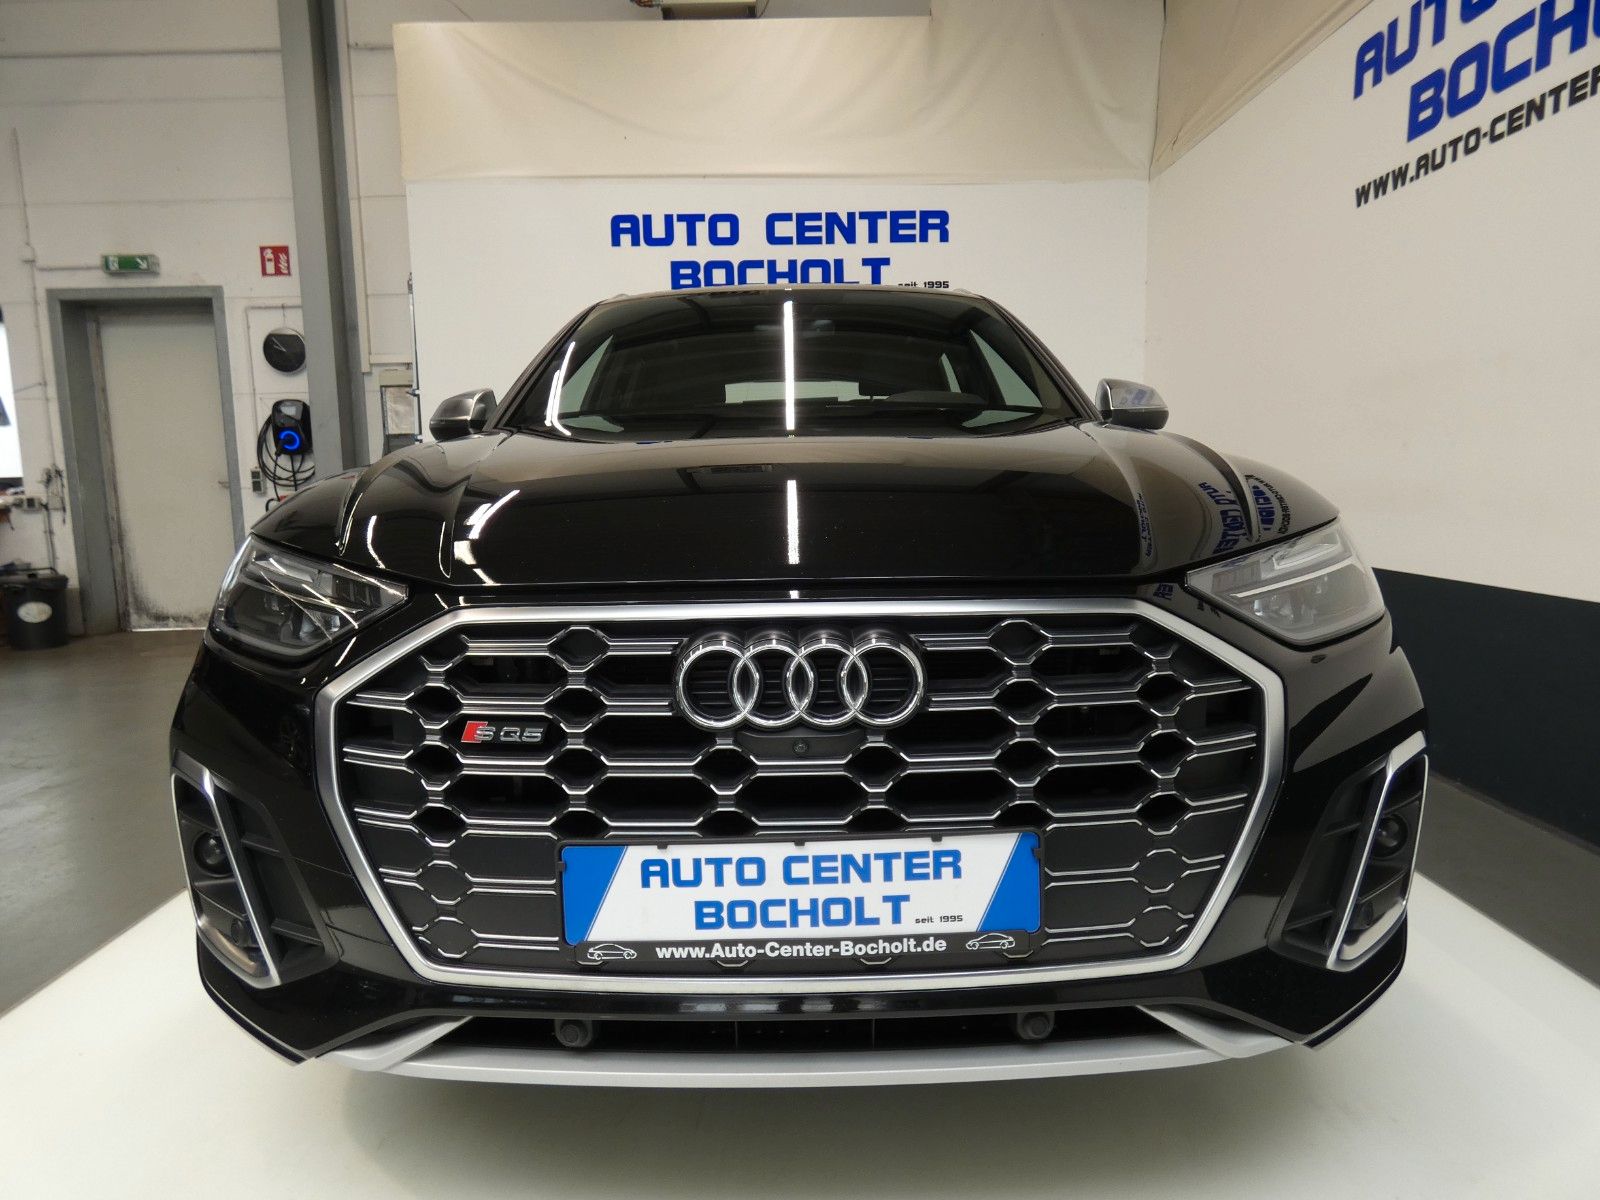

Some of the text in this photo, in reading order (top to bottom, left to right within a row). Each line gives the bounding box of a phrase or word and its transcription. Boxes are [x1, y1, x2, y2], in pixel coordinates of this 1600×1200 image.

[1407, 0, 1600, 143] BOCH
[610, 209, 950, 248] AUTO CENTER
[670, 257, 891, 291] BOCHOLT
[923, 280, 950, 289] 1995
[640, 848, 963, 889] AUTO CENTER
[694, 894, 964, 931] BOCHOLT seit 1995
[655, 936, 948, 960] www.Auto-Center-Bocholt.de
